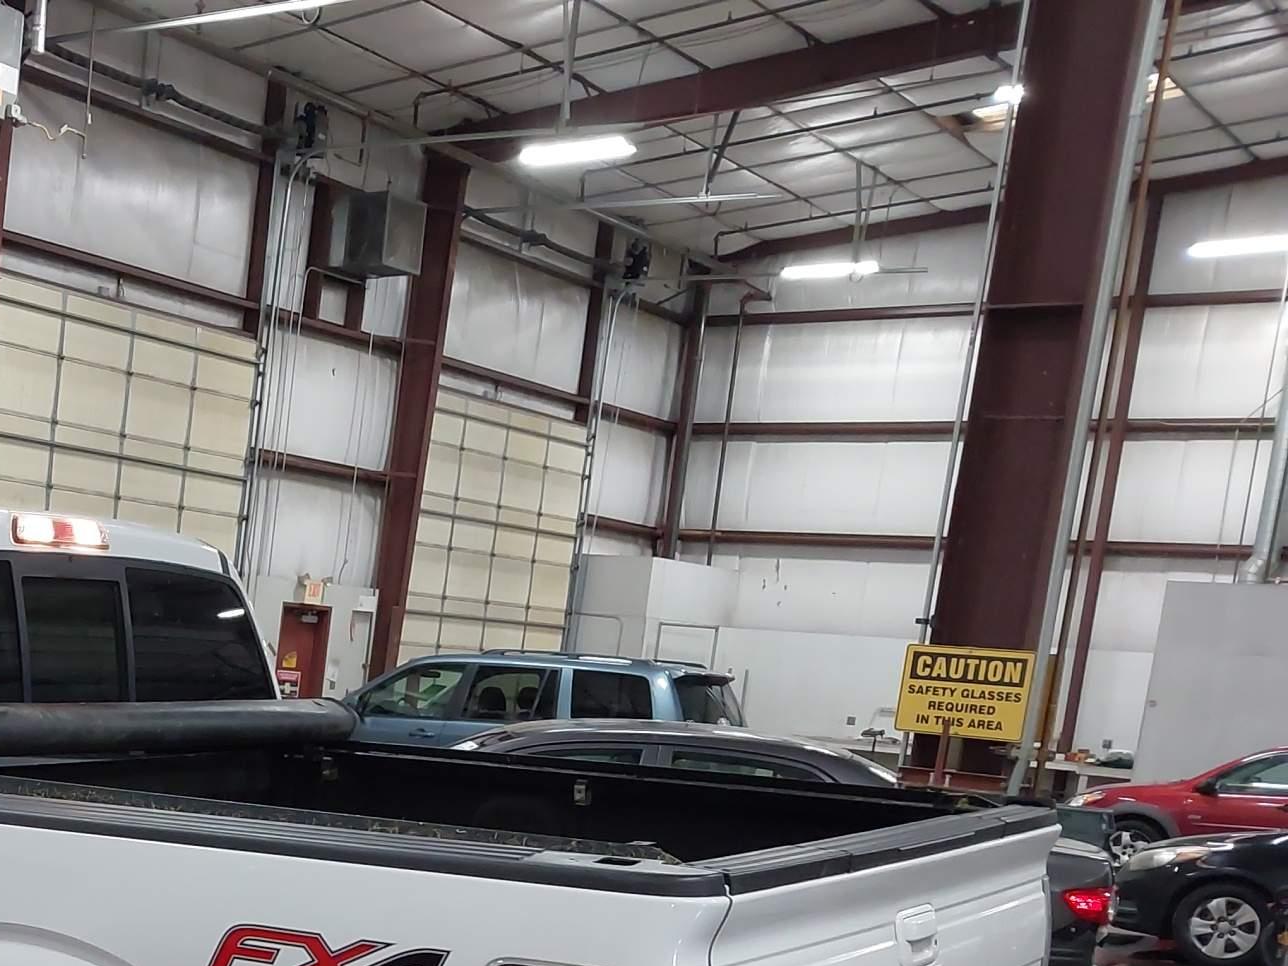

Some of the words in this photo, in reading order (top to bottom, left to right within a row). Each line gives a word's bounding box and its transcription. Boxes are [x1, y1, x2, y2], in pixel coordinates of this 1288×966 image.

[916, 655, 1022, 684] CAUTION
[908, 684, 957, 698] SAFETY
[961, 688, 1022, 703] GLASSES
[927, 700, 996, 715] REQUIRED
[915, 713, 930, 724] IN
[934, 715, 964, 727] THIS
[967, 718, 1003, 731] AREA
